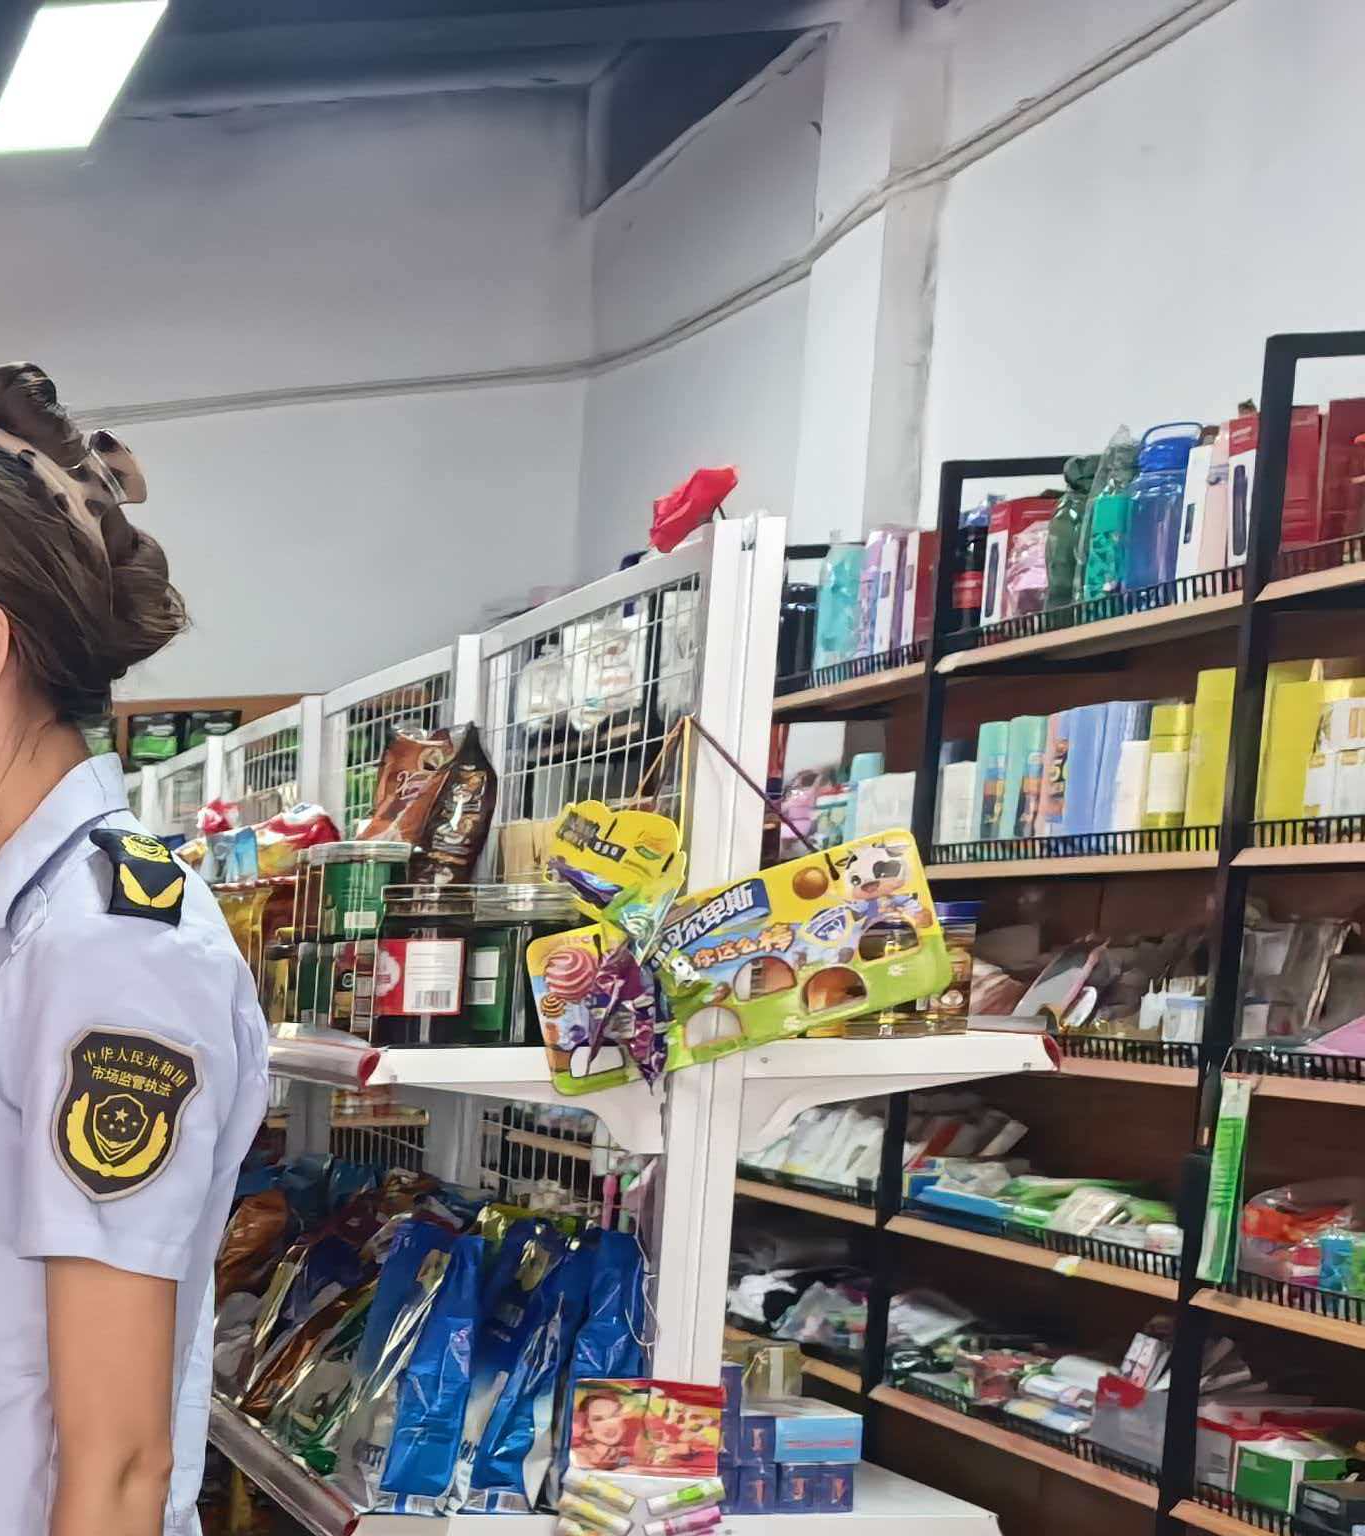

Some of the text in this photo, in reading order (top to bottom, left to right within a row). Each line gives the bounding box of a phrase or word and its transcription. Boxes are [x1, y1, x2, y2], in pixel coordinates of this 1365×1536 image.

[83, 1046, 188, 1087] 中华人民共和国
[93, 1065, 172, 1097] 市场监管执法
